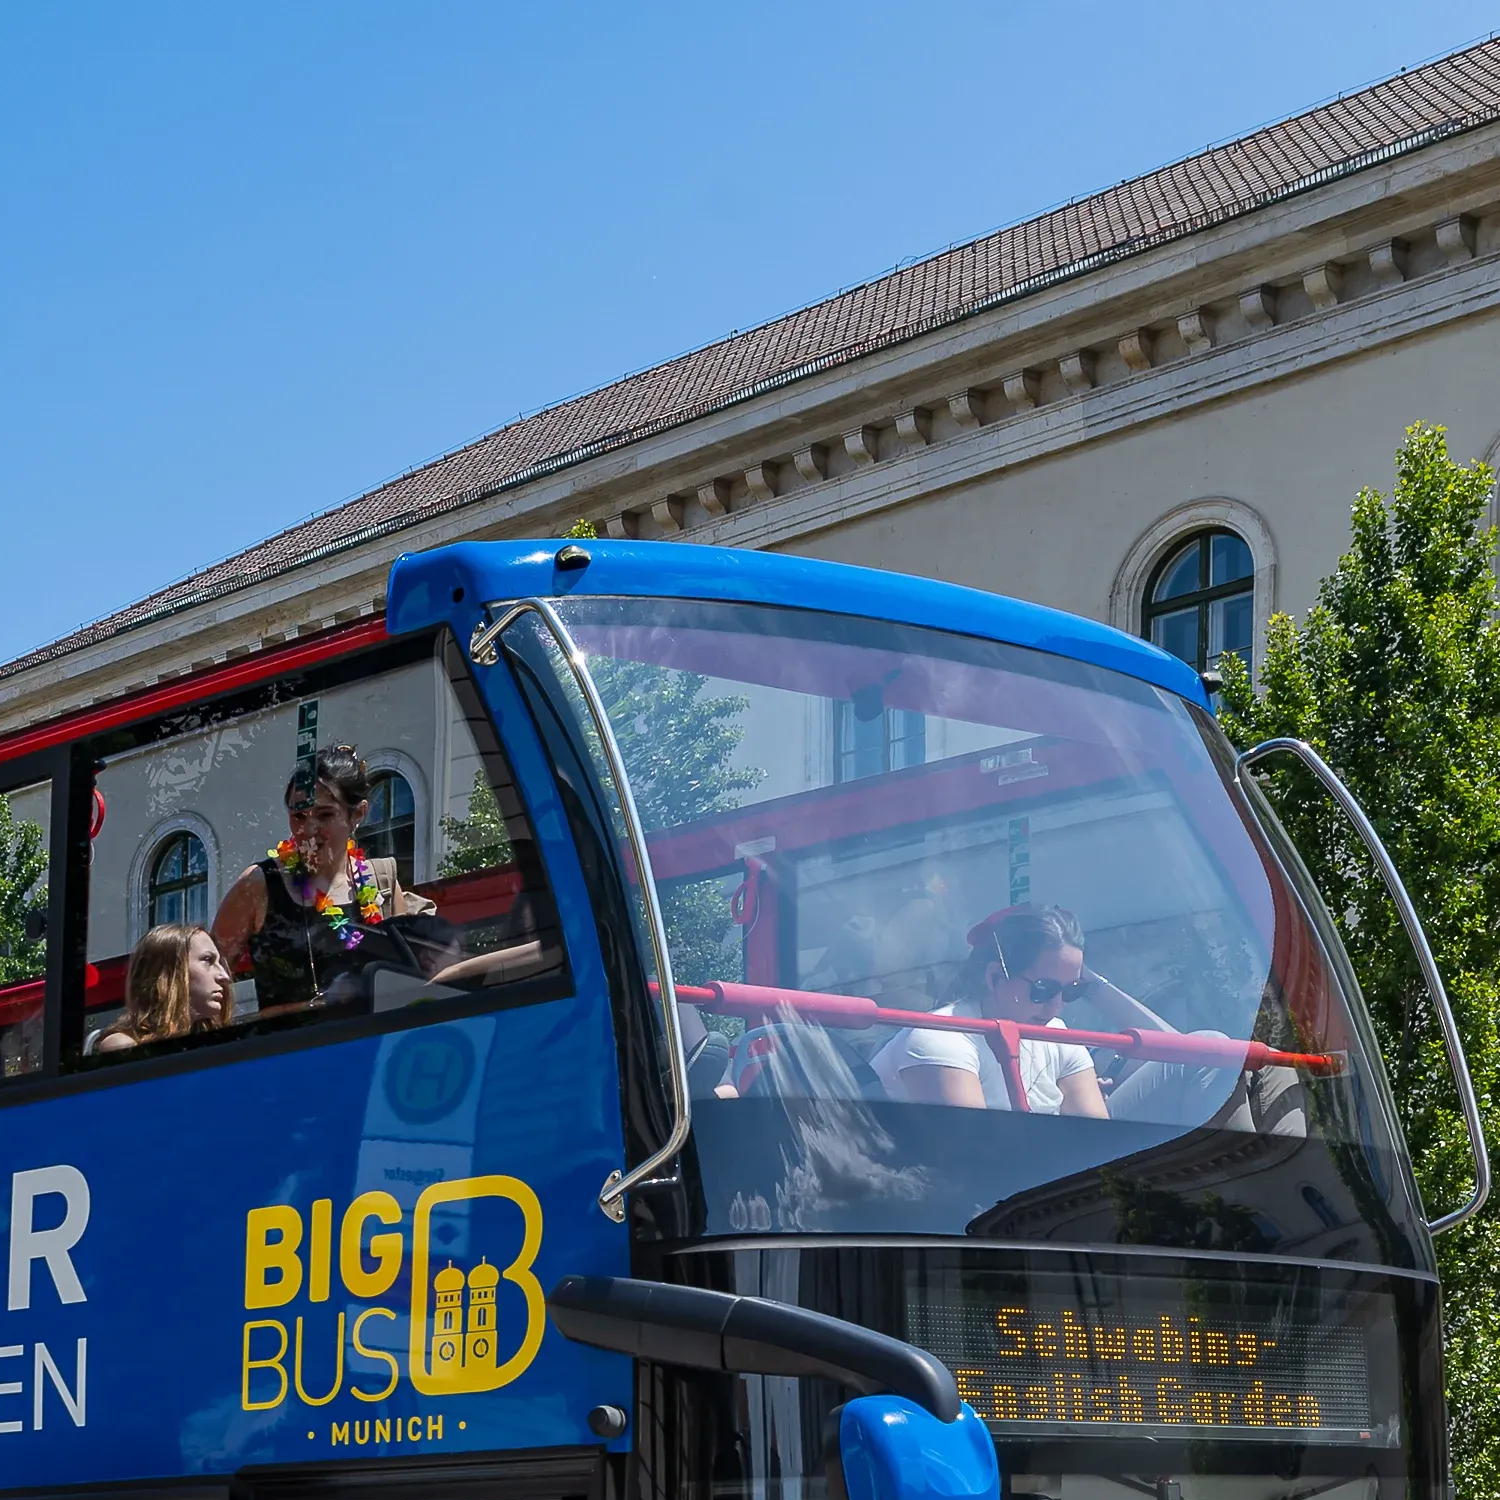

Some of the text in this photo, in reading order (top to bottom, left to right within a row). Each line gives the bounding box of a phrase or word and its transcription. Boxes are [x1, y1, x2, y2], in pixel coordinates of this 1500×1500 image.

[244, 1190, 403, 1310] BIG
[242, 1307, 399, 1411] BUS
[956, 1369, 1320, 1428] English Garden
[331, 1415, 444, 1446] MUNICH
